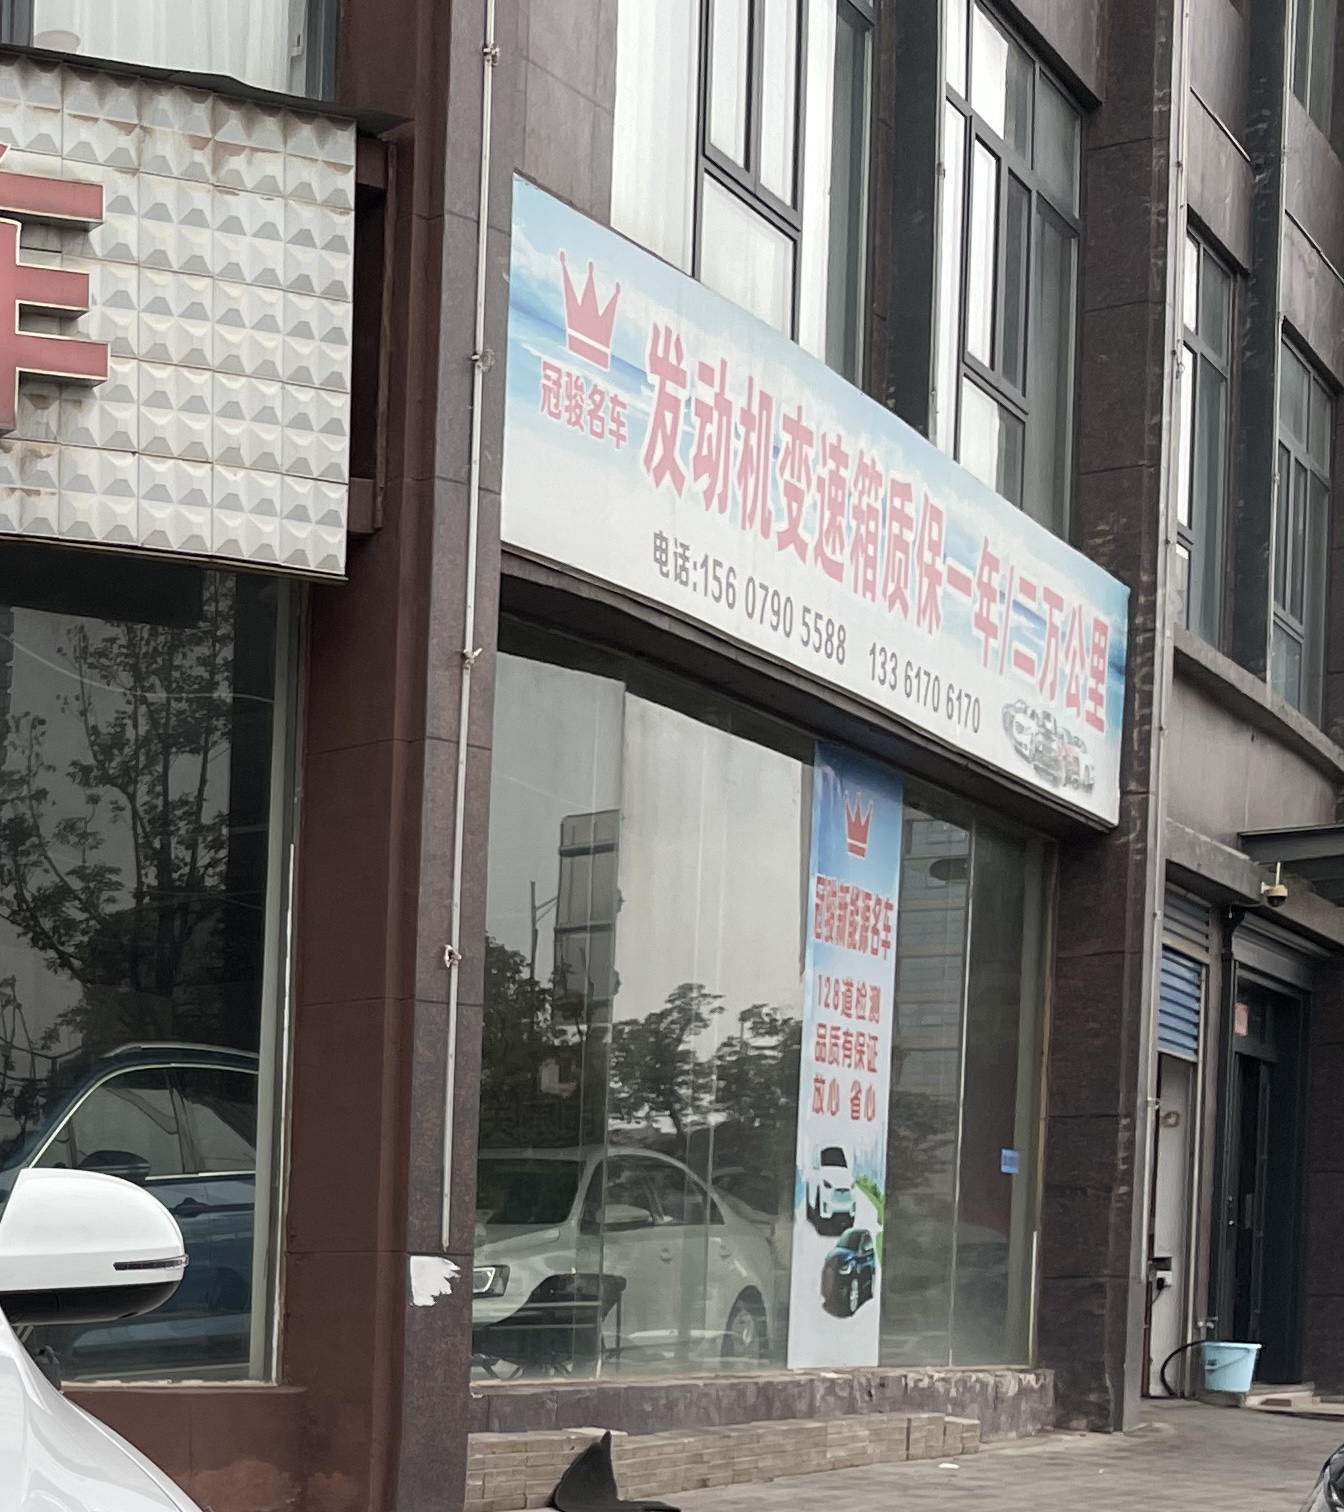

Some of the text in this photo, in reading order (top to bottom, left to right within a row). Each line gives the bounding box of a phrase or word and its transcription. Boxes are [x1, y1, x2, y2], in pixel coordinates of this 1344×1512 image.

[540, 359, 629, 449] 冠骏名车
[644, 321, 1109, 733] 发动机变速箱质保一年/二万公里
[745, 577, 793, 638] 0790
[801, 605, 846, 665] 5588
[869, 642, 897, 690] 133
[905, 660, 940, 713] 6170
[946, 683, 981, 733] 6170
[815, 1022, 878, 1073] 品质有保证
